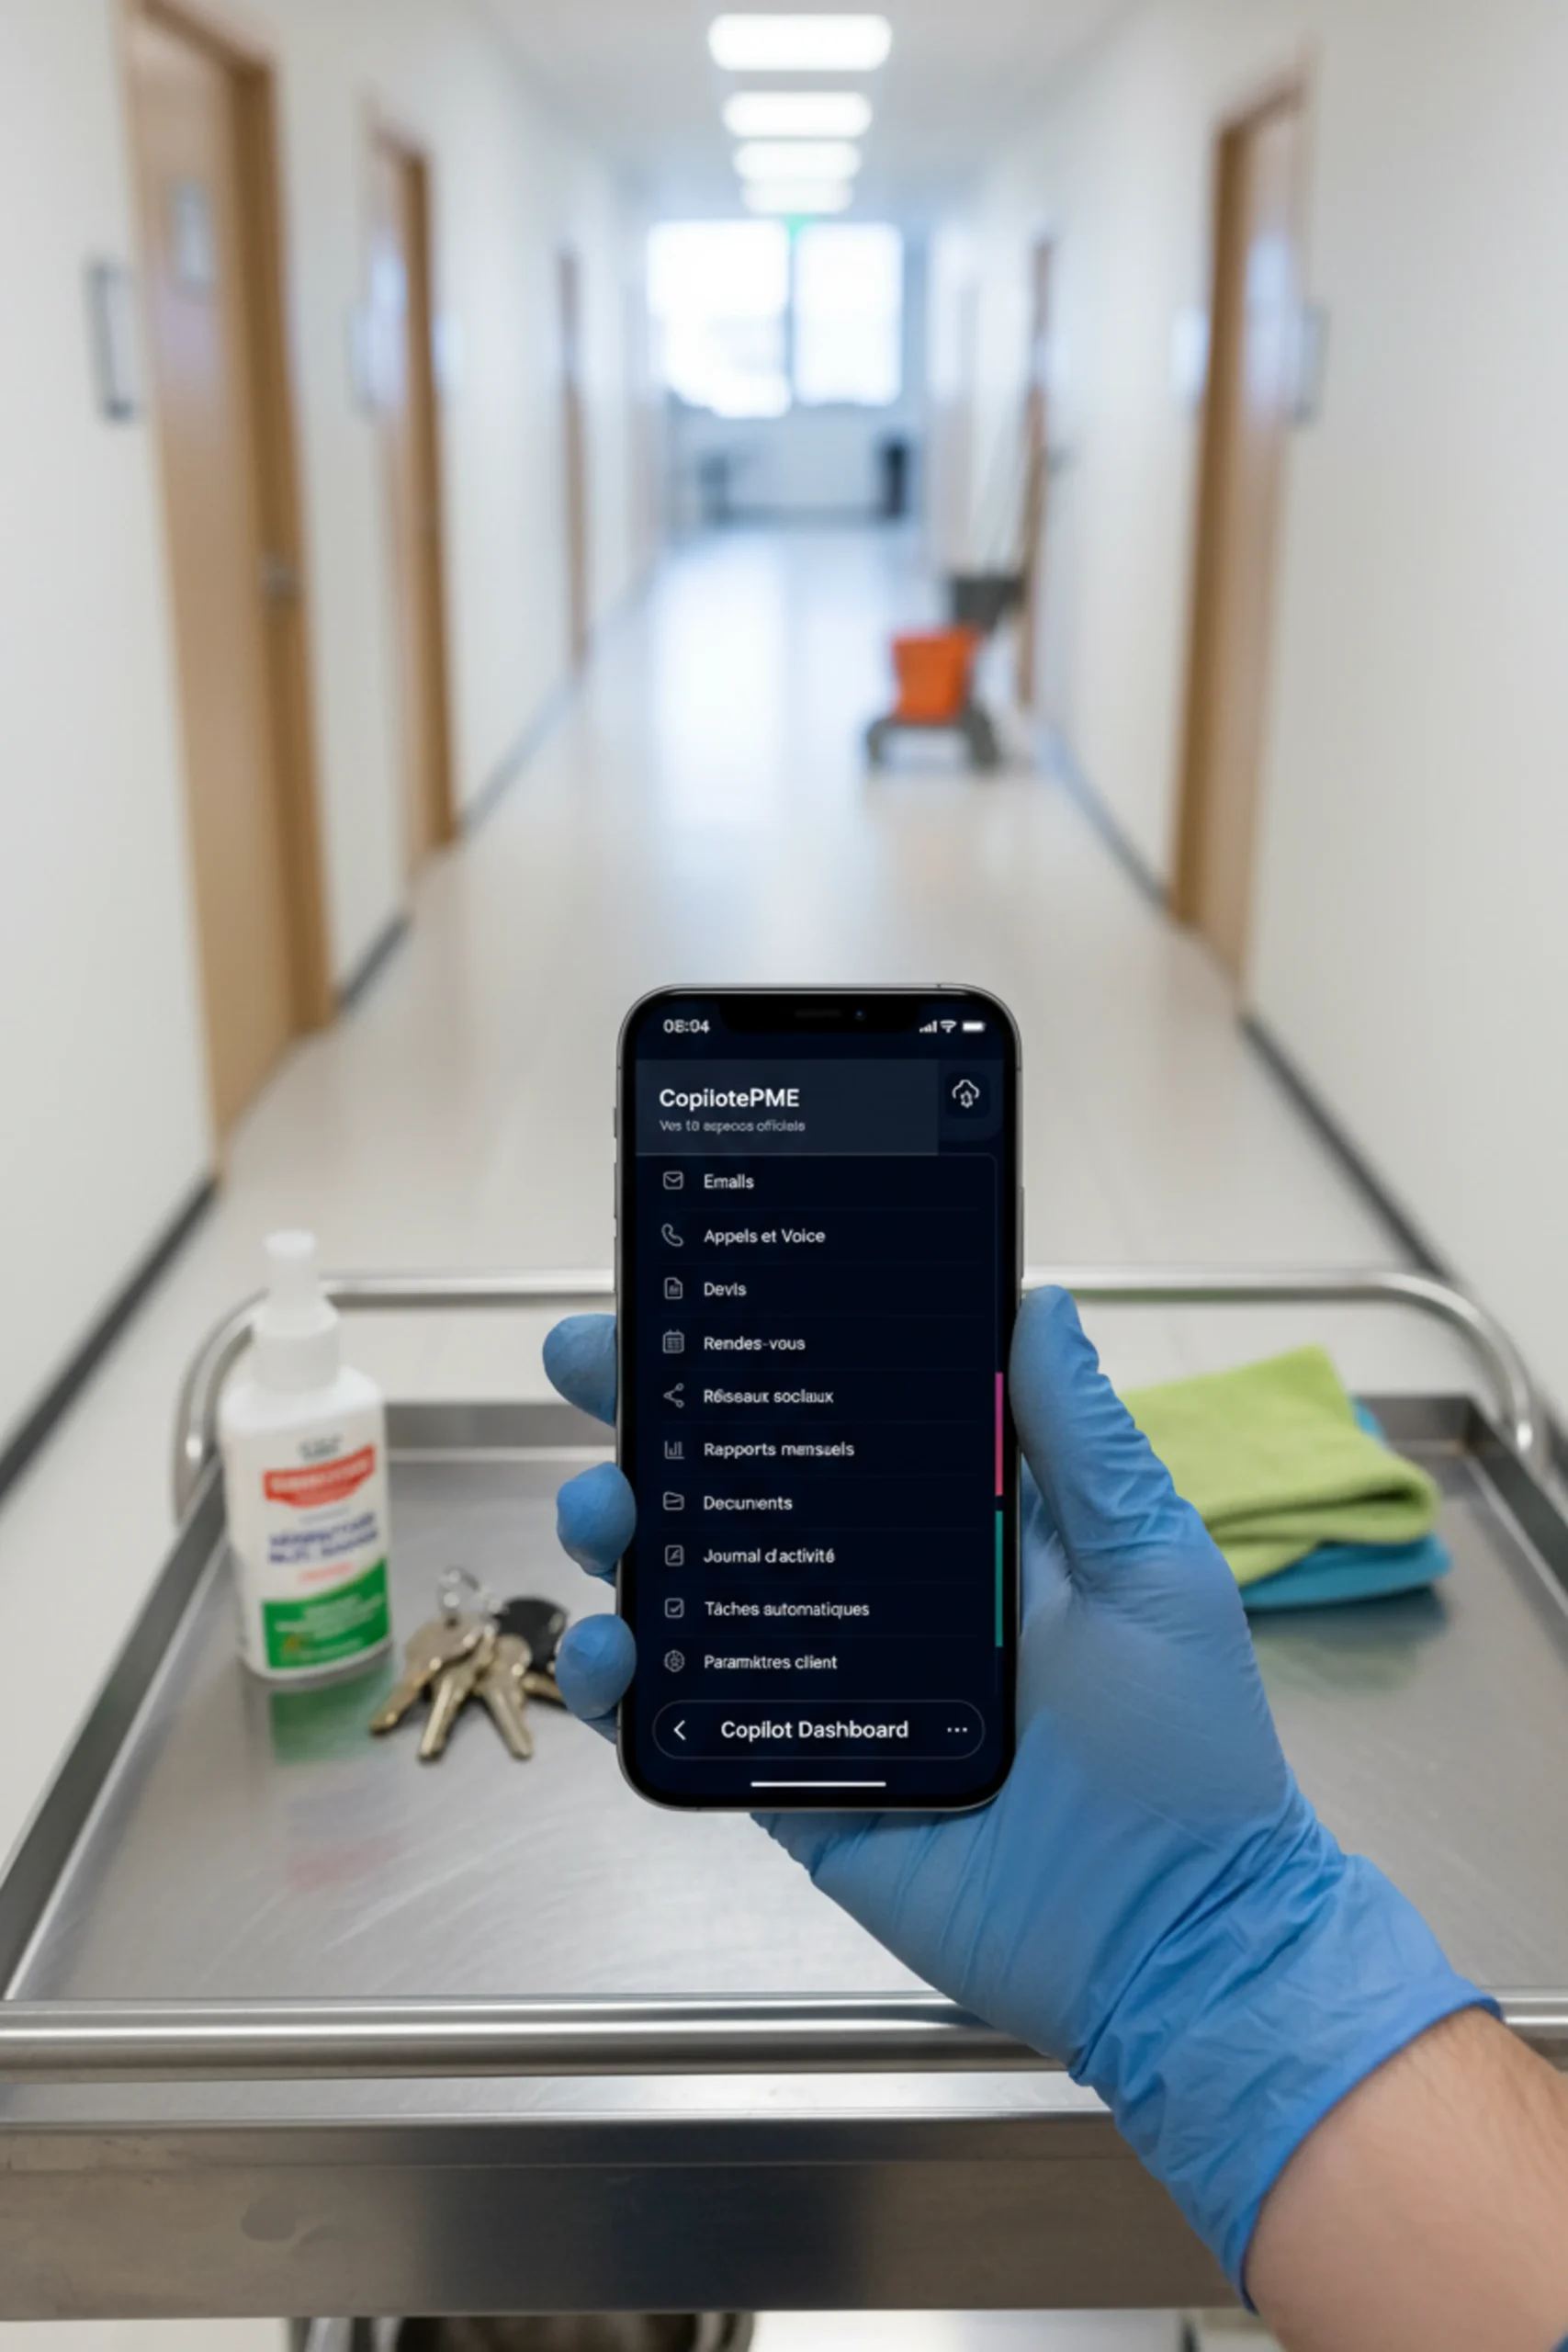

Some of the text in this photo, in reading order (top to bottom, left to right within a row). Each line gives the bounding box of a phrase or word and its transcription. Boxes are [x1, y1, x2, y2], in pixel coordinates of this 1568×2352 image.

[659, 1088, 800, 1112] CopilotePME
[704, 1227, 826, 1246] Appels et Voice
[704, 1336, 806, 1350] Rendes-vous
[704, 1442, 776, 1459] Rapports
[705, 1600, 870, 1619] Tâches automatiques
[795, 1654, 838, 1668] client
[720, 1719, 909, 1742] Copilot Dashboard
